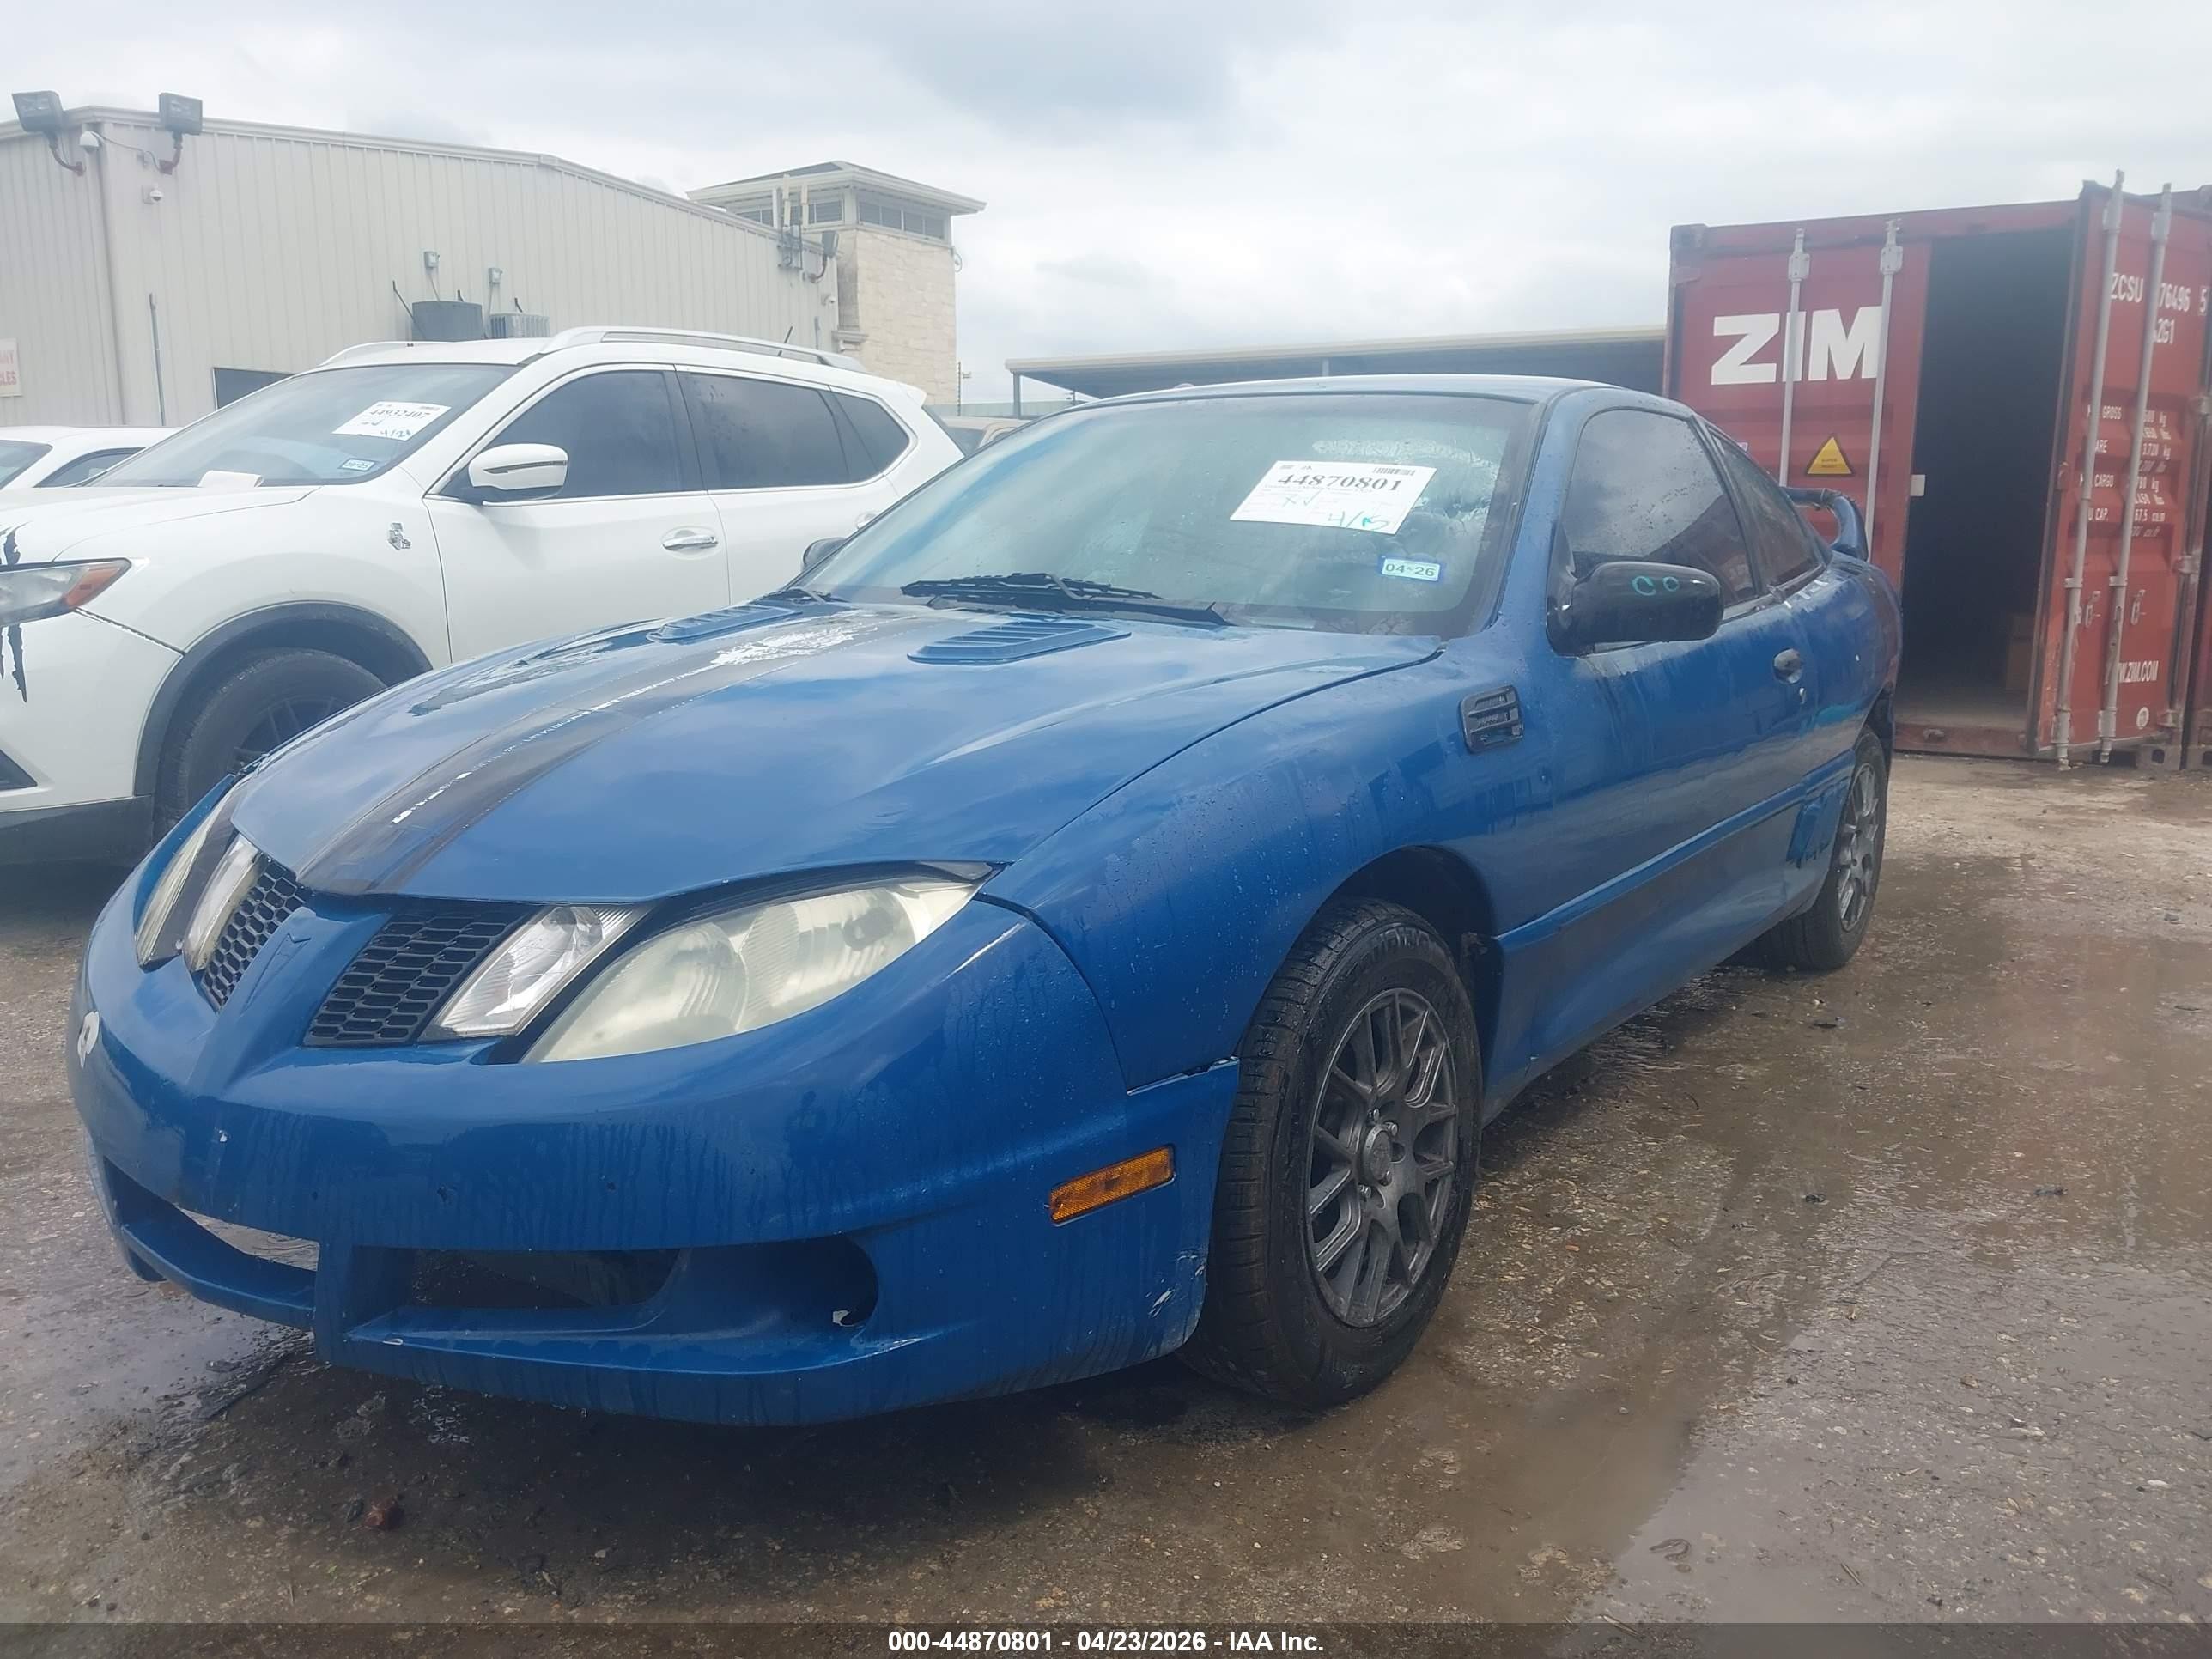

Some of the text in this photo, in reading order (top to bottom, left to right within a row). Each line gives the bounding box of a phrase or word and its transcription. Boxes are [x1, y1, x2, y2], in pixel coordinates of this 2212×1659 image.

[2111, 273, 2145, 303] ZCSU
[1711, 306, 1883, 385] ZIM
[2101, 405, 2122, 420] GROSS
[2095, 440, 2108, 453] ARE
[1278, 473, 1402, 491] 44870801
